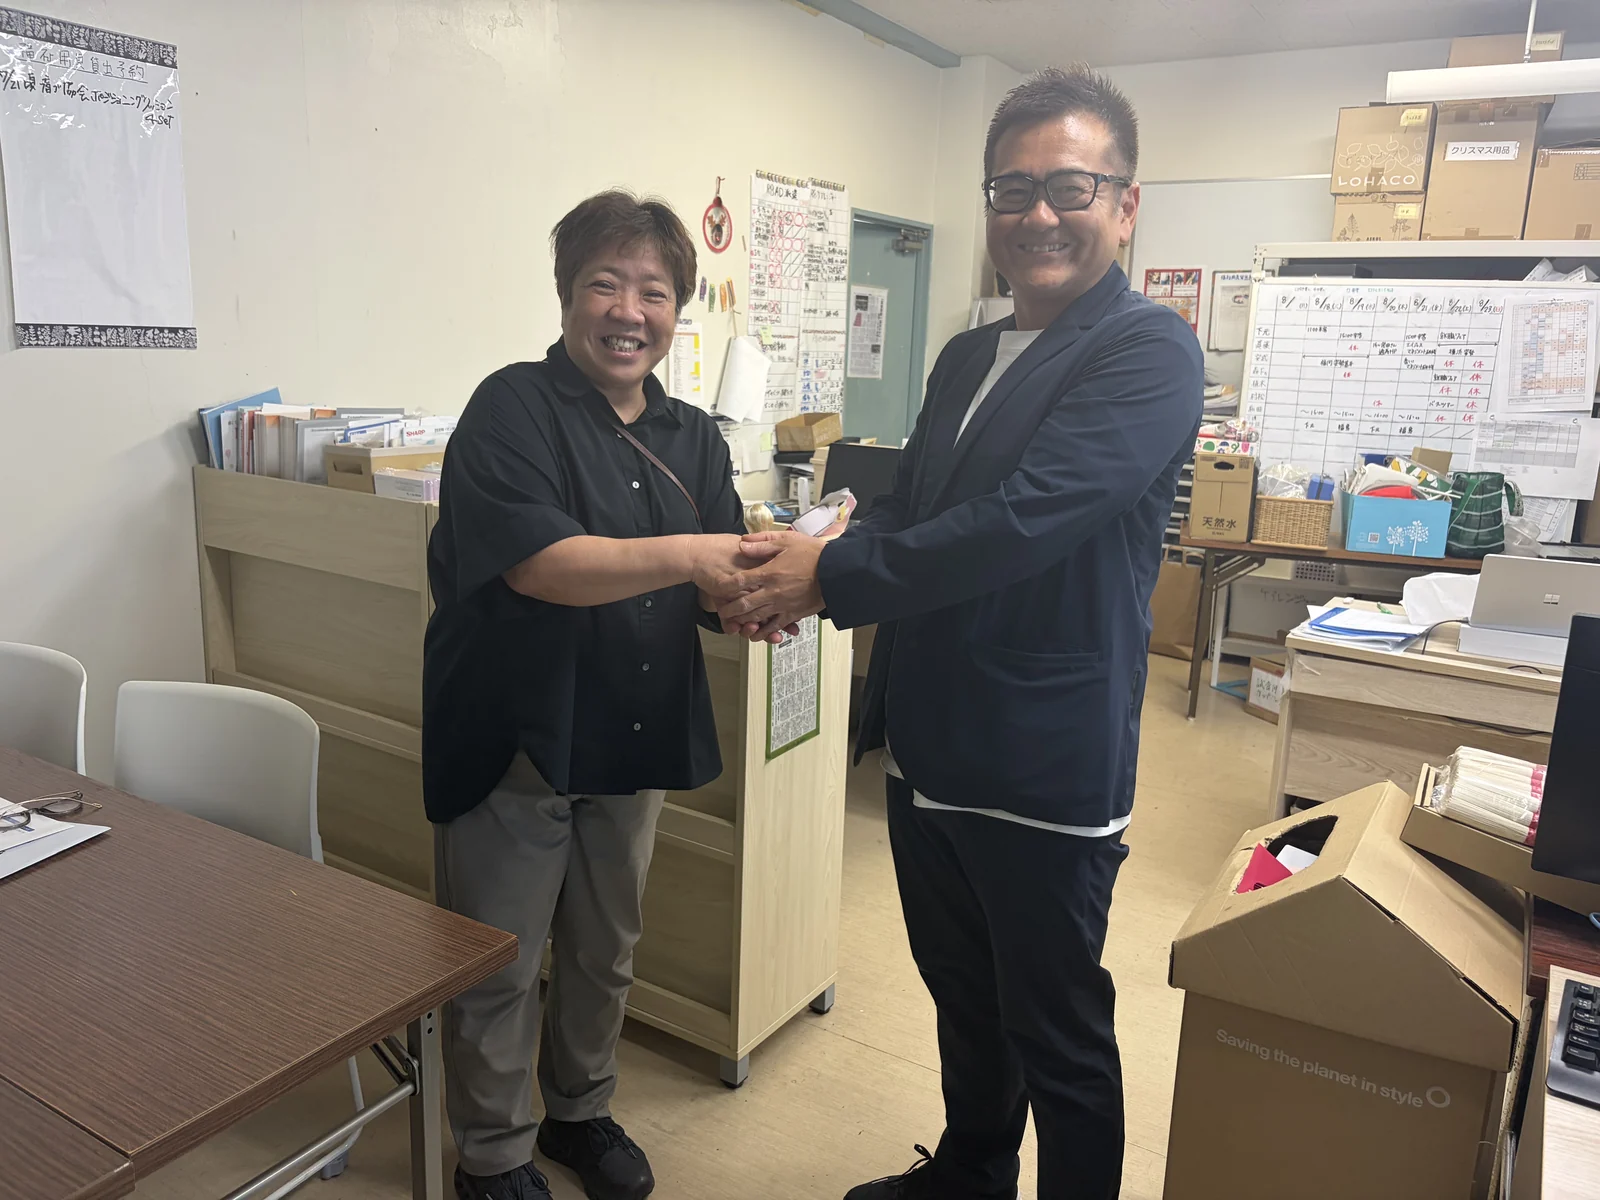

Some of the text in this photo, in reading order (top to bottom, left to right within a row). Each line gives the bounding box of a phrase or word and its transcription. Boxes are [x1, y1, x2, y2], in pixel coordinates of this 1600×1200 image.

[1451, 145, 1510, 155] クリスマス用品
[1472, 360, 1485, 369] 休
[1469, 373, 1482, 381] 休
[1468, 387, 1481, 396] 休
[1466, 401, 1478, 409] 休
[1462, 413, 1475, 423] 休
[406, 429, 426, 437] SHARP
[1202, 516, 1237, 529] 天然水
[1216, 1028, 1424, 1108] Saving the planet in style
